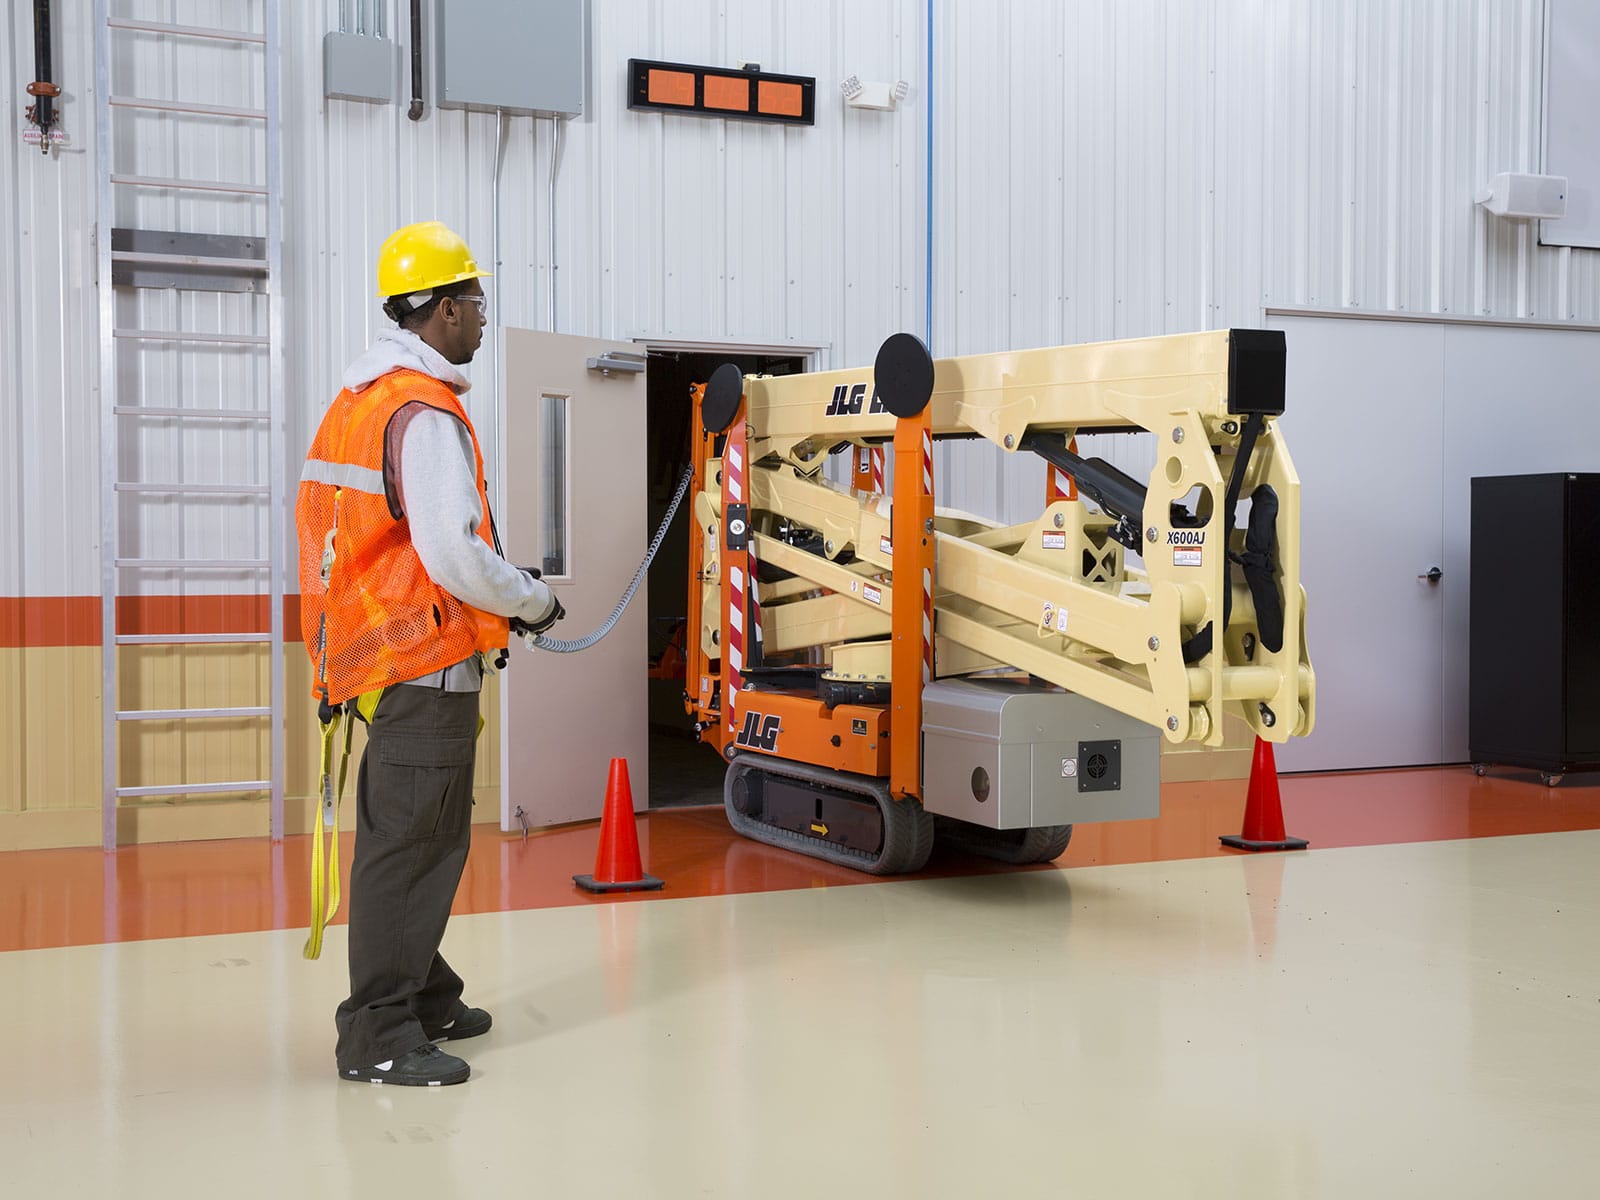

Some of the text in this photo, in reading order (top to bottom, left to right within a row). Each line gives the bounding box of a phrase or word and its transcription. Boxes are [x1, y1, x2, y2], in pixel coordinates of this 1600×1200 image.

[825, 384, 867, 416] JLG
[1166, 531, 1206, 545] X600AJ
[736, 711, 781, 752] JLG
